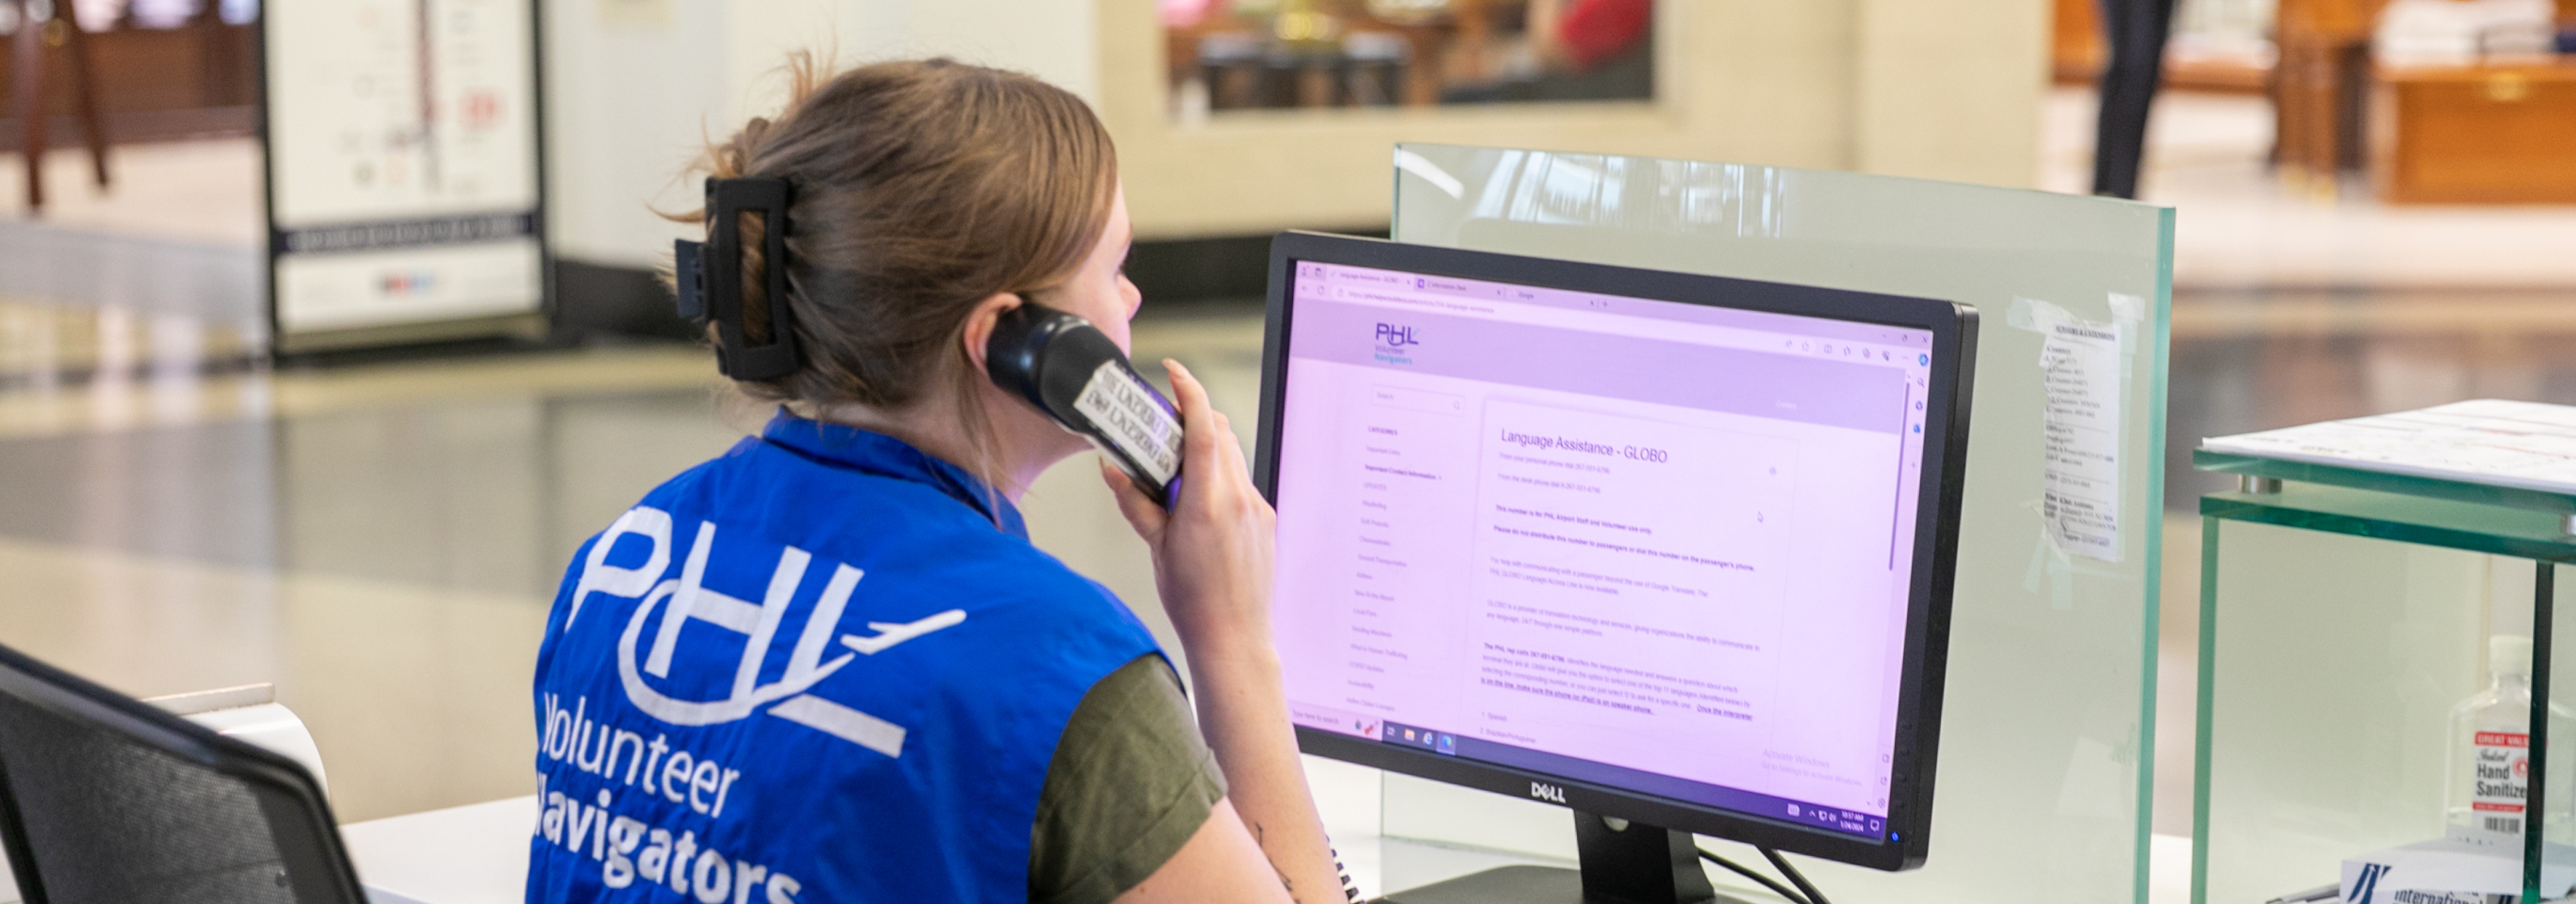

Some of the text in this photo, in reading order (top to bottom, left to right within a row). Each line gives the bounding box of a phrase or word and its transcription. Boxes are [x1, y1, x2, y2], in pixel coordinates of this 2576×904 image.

[1376, 322, 1418, 346] PHL
[1501, 428, 1553, 451] Language
[1555, 435, 1613, 456] Assistance
[1624, 444, 1668, 464] GLOBO
[565, 506, 907, 759] PHL
[542, 691, 740, 818] Volunteer
[1794, 753, 1830, 769] Windows
[2476, 762, 2510, 780] Hand
[1531, 781, 1566, 804] DELL
[2476, 781, 2529, 798] Sanitize
